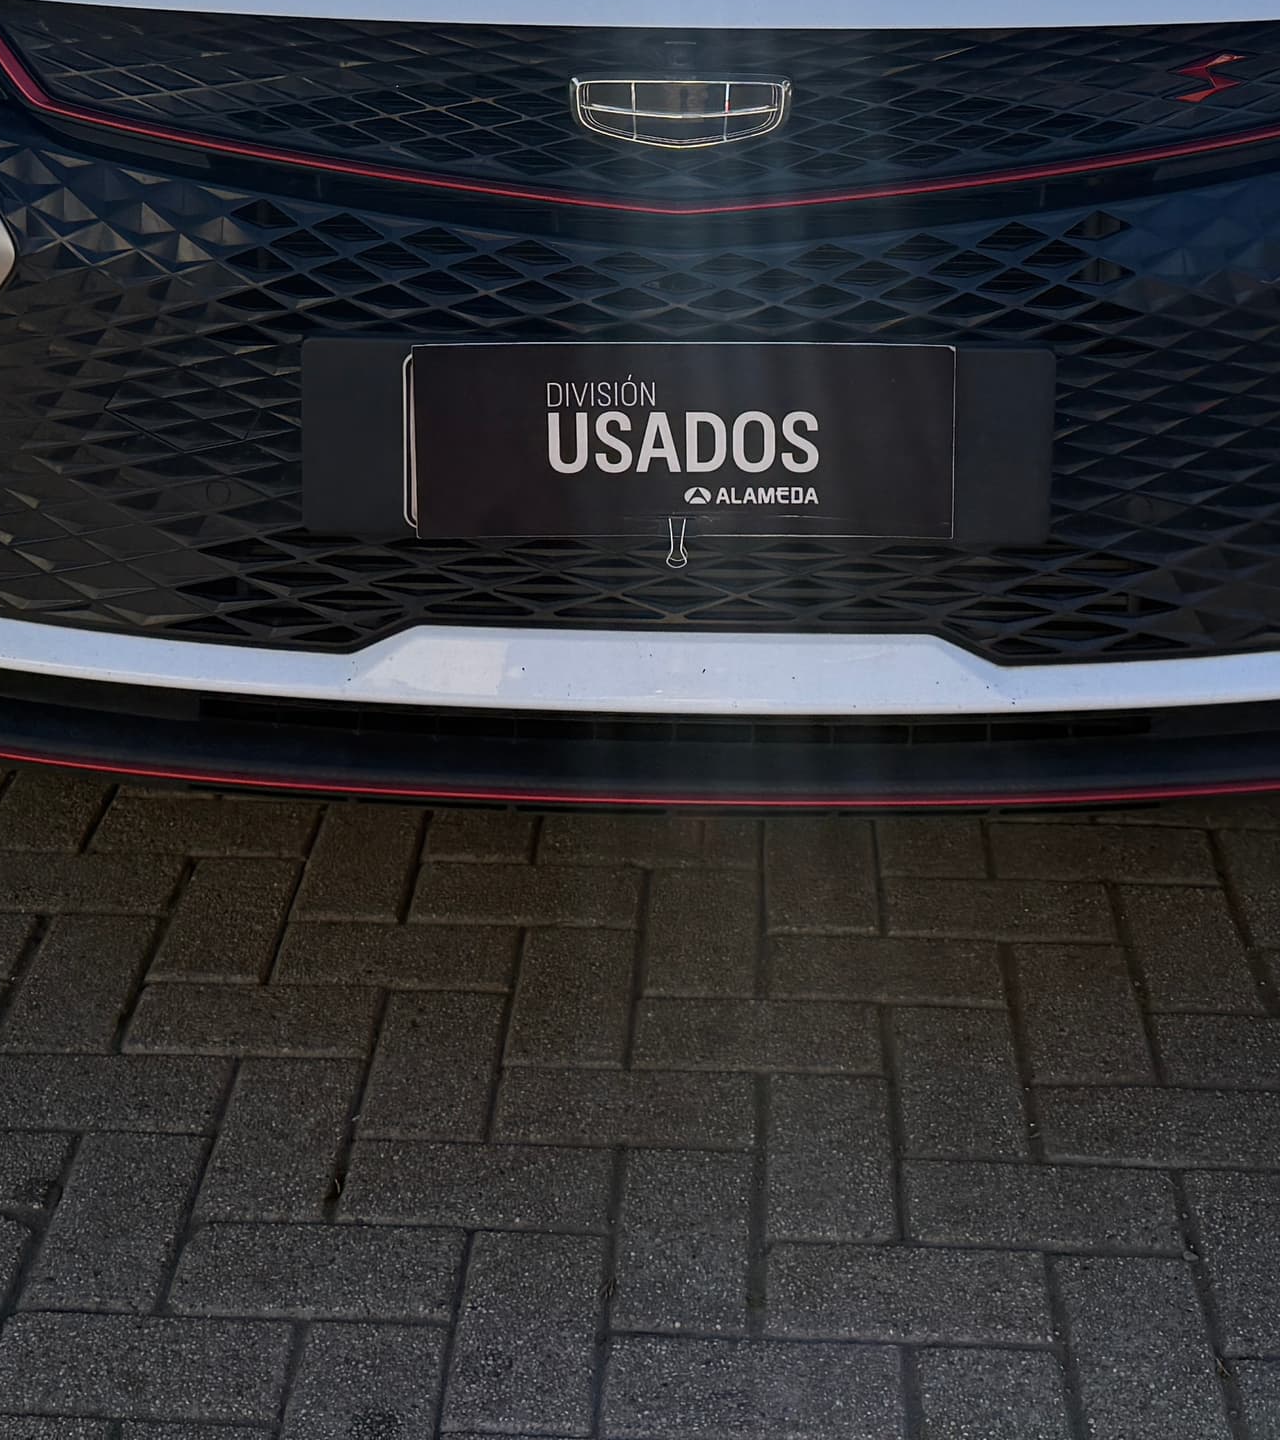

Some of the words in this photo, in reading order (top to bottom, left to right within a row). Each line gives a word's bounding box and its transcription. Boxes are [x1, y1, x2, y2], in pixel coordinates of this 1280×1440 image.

[546, 374, 656, 408] DIVISIÓN
[547, 410, 820, 474] USADOS
[716, 487, 819, 505] ALAMEDA
